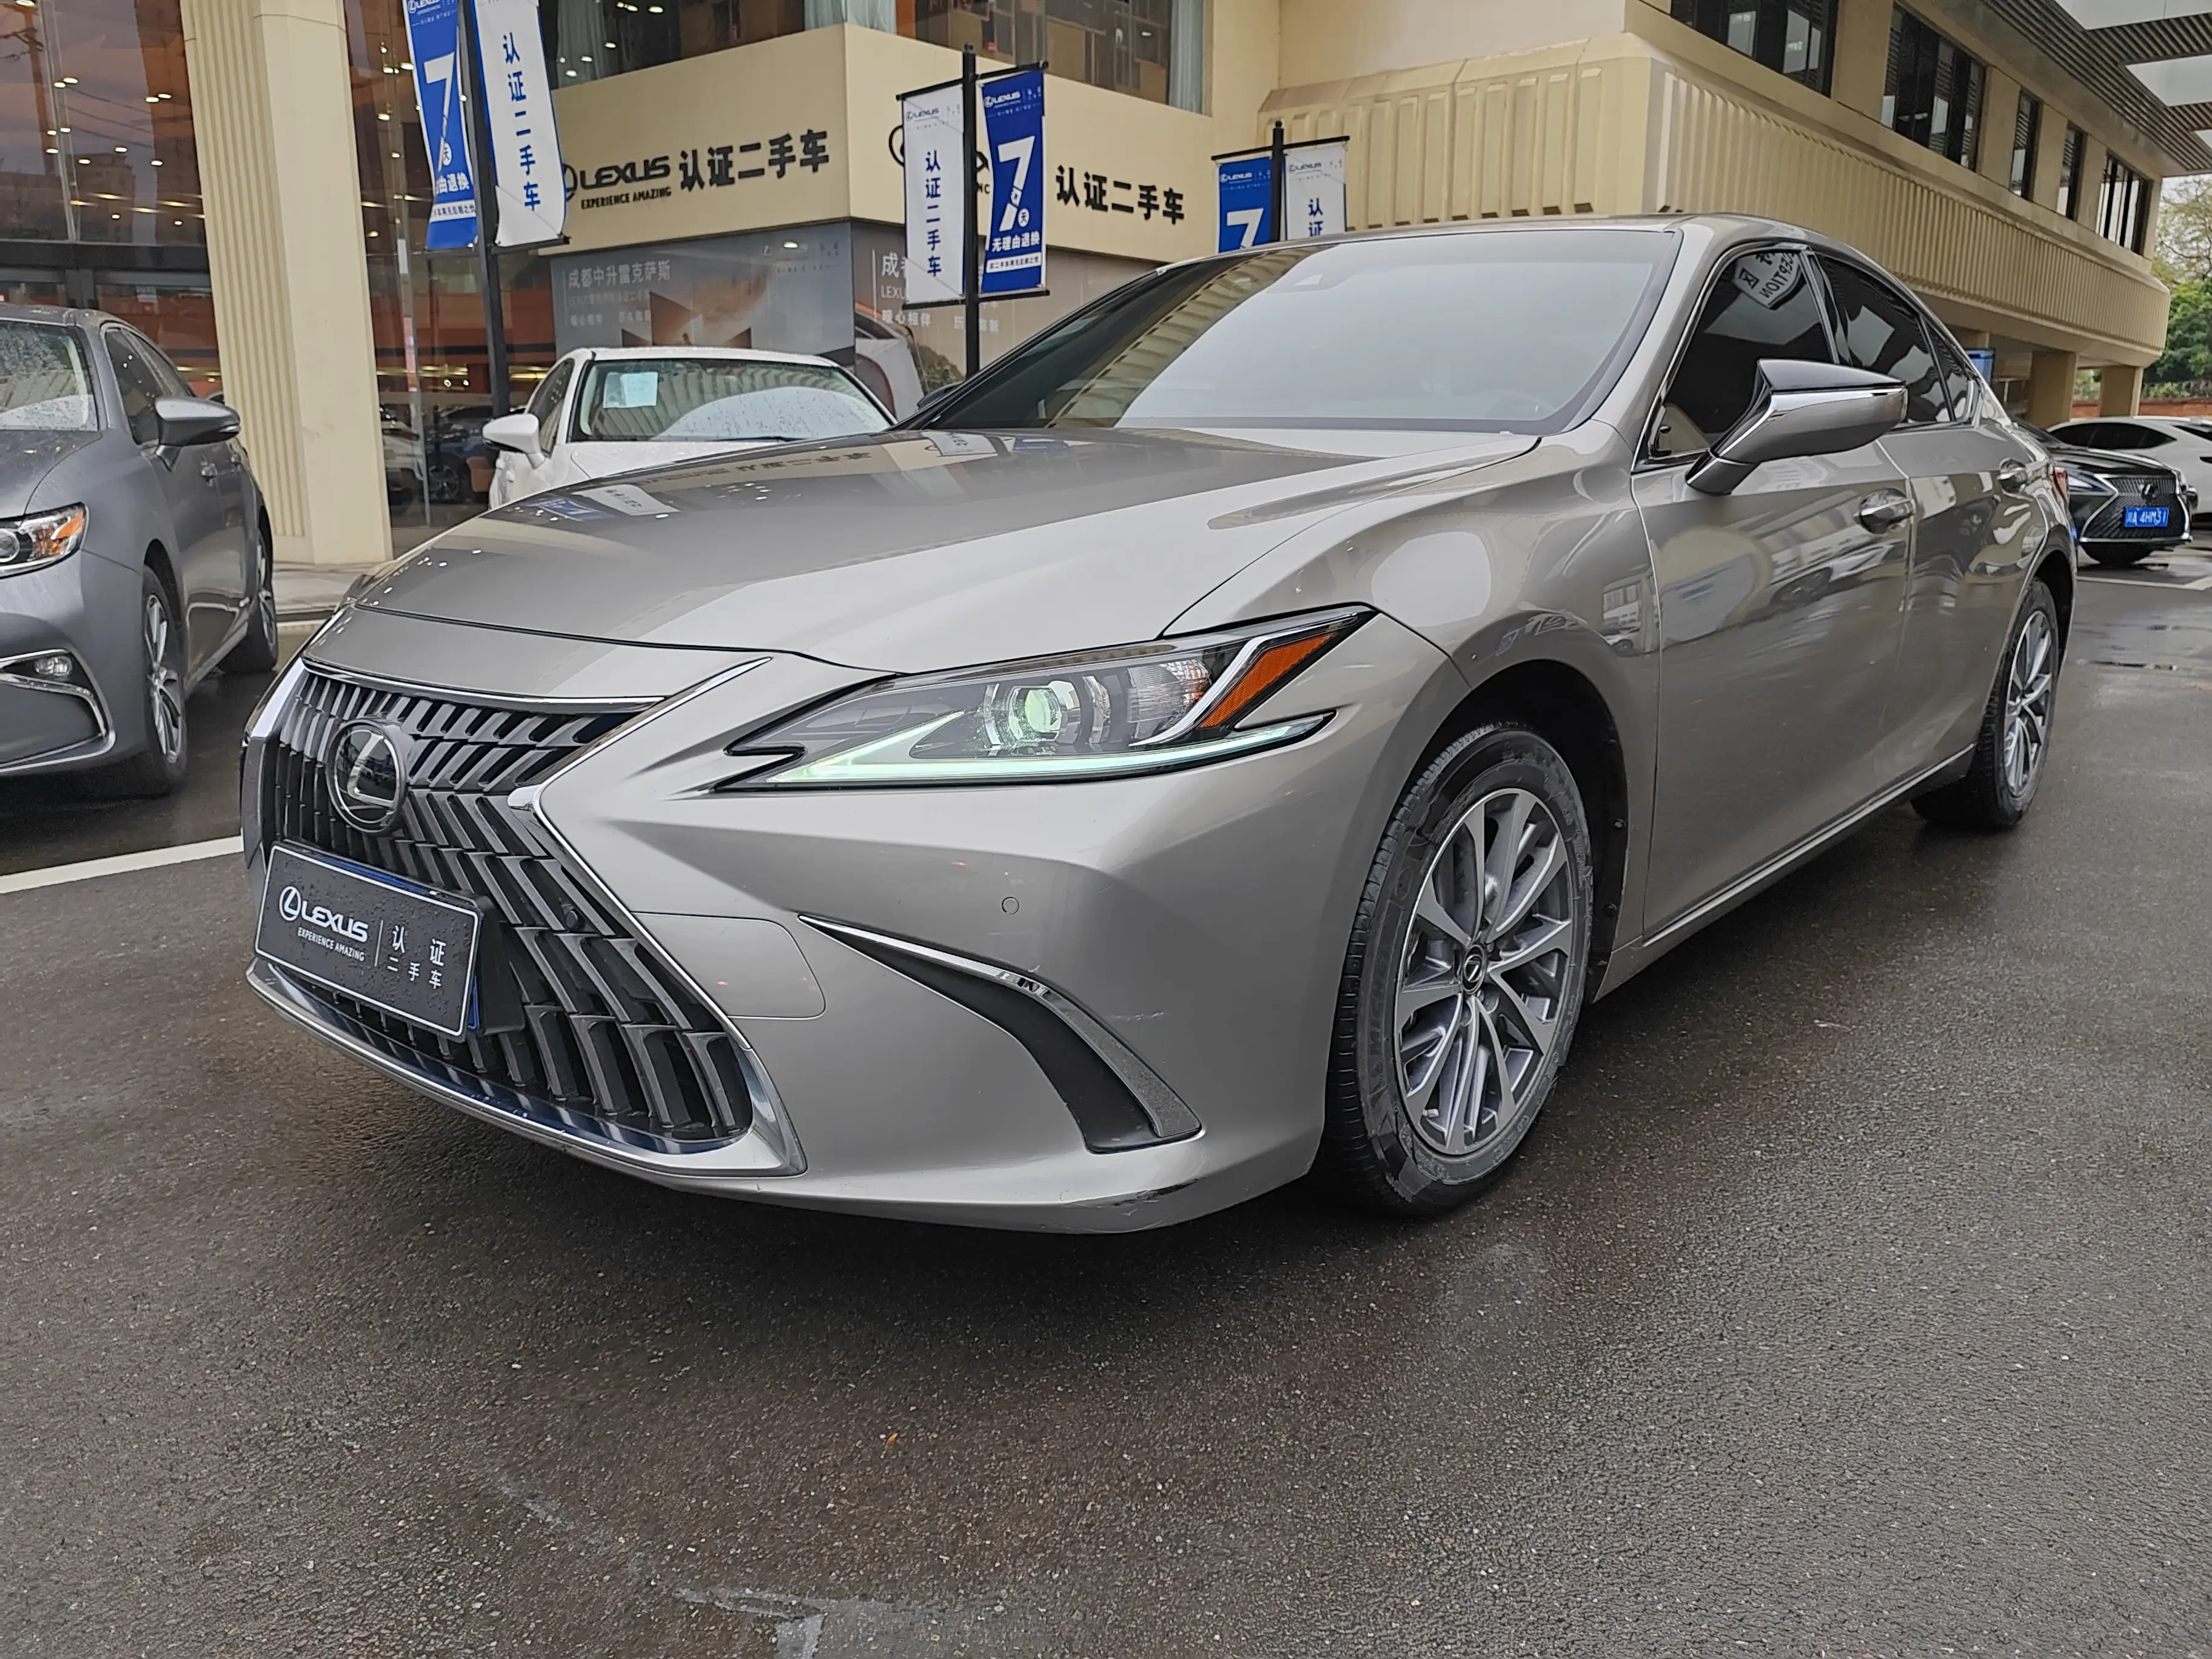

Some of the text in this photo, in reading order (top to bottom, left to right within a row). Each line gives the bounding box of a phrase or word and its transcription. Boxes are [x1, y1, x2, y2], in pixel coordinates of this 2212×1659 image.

[424, 52, 454, 172] 7
[913, 107, 940, 118] LEXUS
[993, 91, 1021, 104] LEXUS
[503, 32, 541, 211] 认证二手车
[580, 155, 671, 190] LEXUS
[679, 129, 830, 192] 认证二手车
[436, 172, 471, 194] 由退换
[581, 187, 672, 210] EXPERIENCE AMAZING
[997, 135, 1036, 232] 7
[1056, 164, 1185, 225] 认证二手车
[925, 149, 942, 277] 认证二手车
[991, 230, 1041, 253] 无理由退换
[568, 259, 671, 290] 成都中升雷克萨斯
[882, 309, 931, 327] 暖心相伴
[302, 900, 369, 942] LEXUS
[298, 927, 364, 962] EXPERIENCE AMAZING
[392, 925, 446, 967] 认证
[387, 956, 442, 990] 二手车
